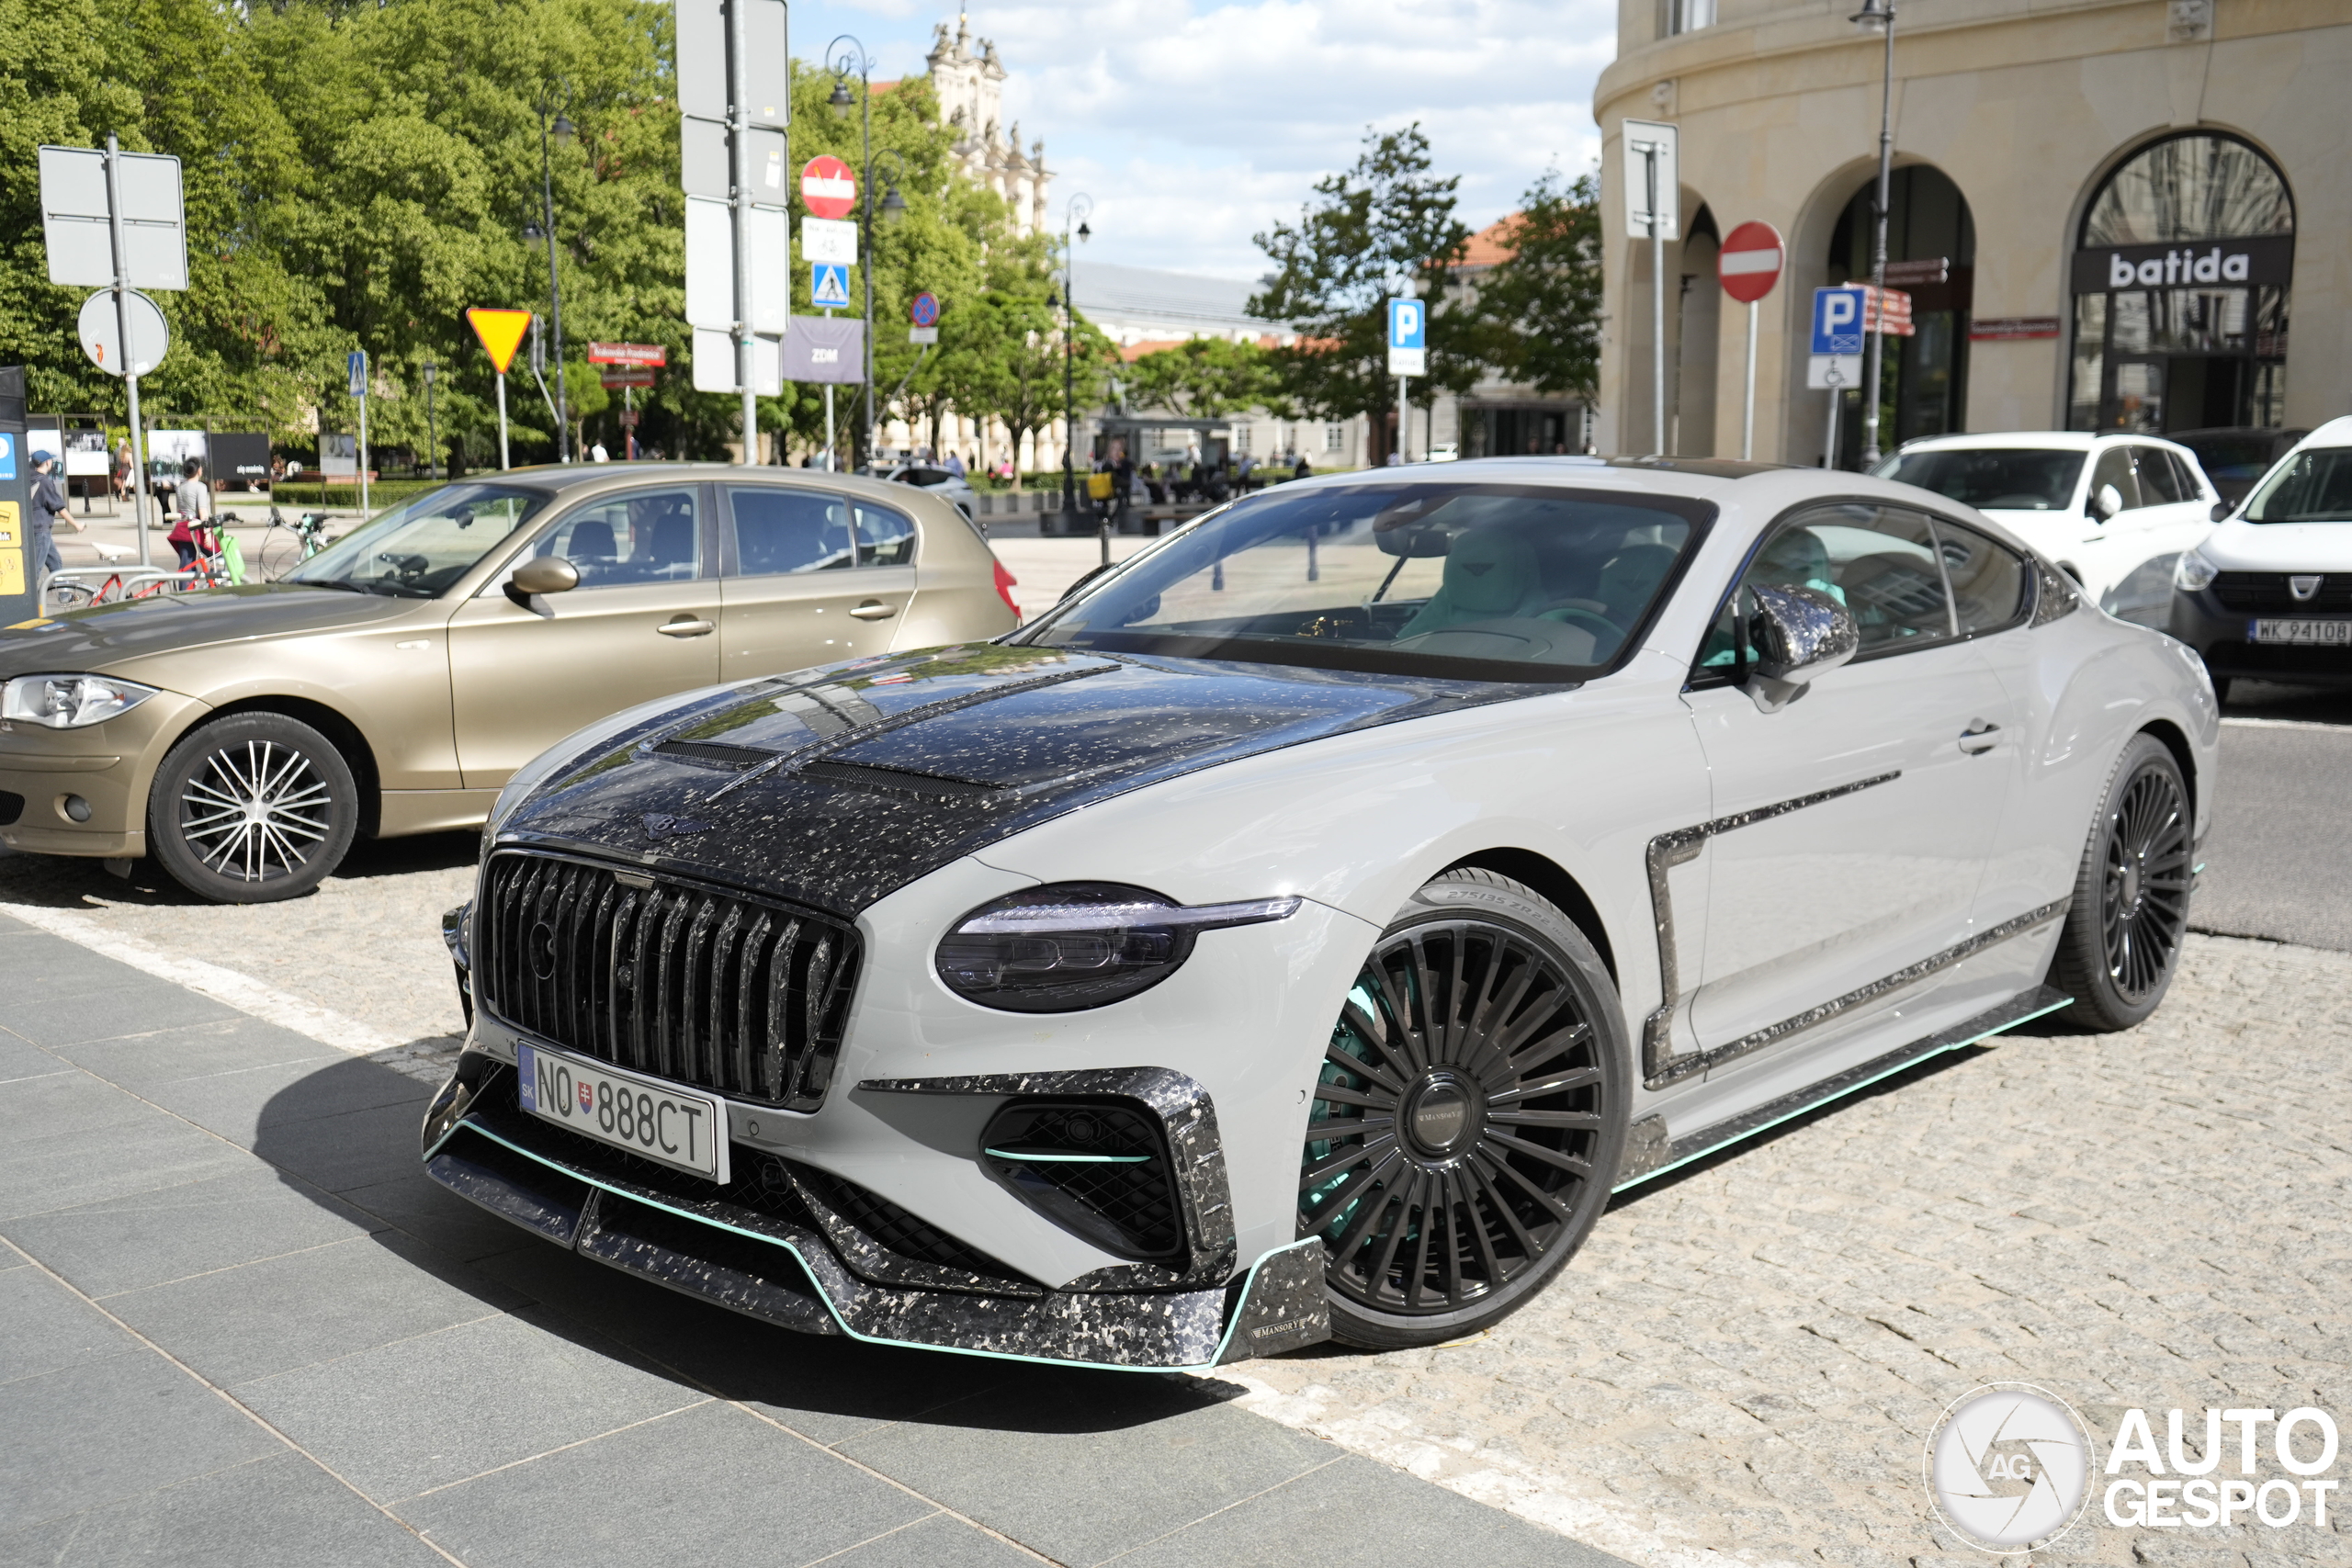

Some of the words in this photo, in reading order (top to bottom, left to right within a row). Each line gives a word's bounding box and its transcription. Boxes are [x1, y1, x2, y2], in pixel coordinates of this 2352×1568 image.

[2109, 247, 2249, 288] batida
[1824, 293, 1856, 336] P
[1396, 304, 1419, 345] P
[811, 348, 838, 363] ZDM
[2261, 621, 2282, 639] WK
[2290, 622, 2346, 641] 94108
[1447, 891, 1507, 905] 275/35
[522, 1083, 534, 1100] SK
[537, 1057, 571, 1118] NO
[598, 1081, 701, 1162] 888CT
[1425, 1111, 1455, 1121] MANSORY
[1261, 1320, 1299, 1337] MANSORY
